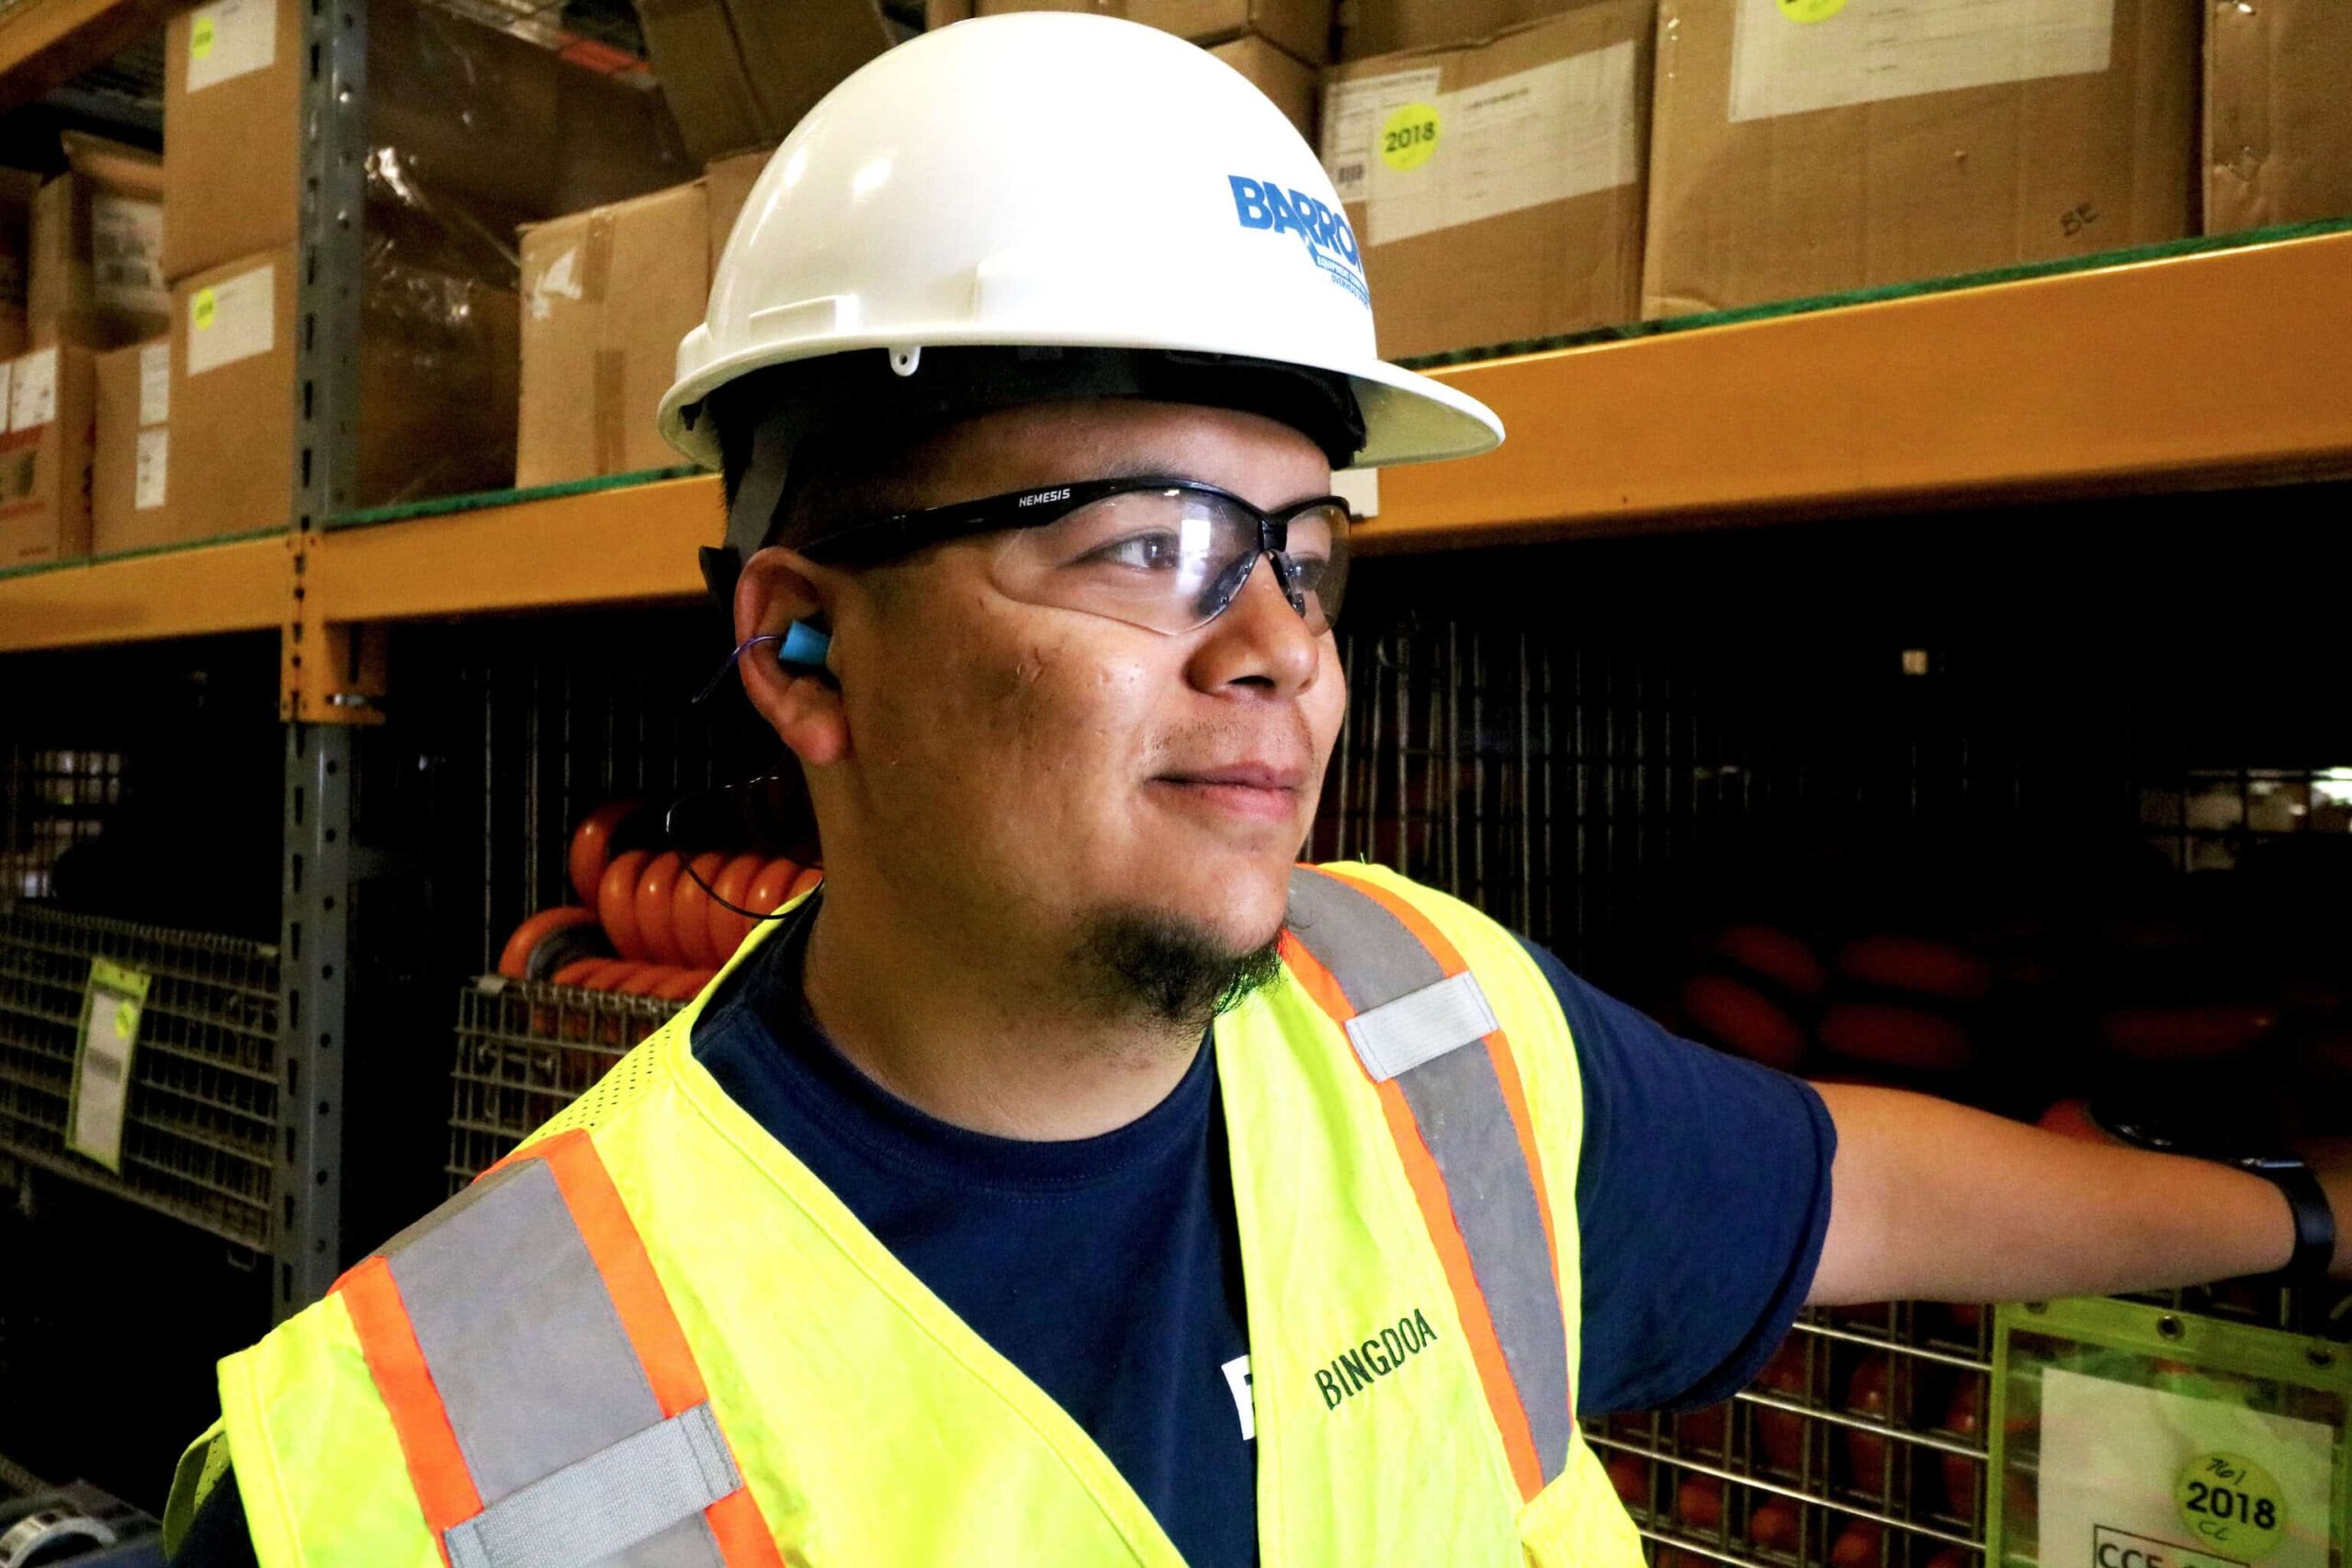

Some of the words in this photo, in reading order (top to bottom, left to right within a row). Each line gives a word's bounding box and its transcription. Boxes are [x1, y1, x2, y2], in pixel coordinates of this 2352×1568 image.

[1385, 120, 1435, 153] 2018
[1227, 175, 1362, 275] BARRO
[1018, 488, 1071, 508] NEMESIS
[1314, 1308, 1438, 1411] BINGDOA
[2186, 1482, 2277, 1530] 2018
